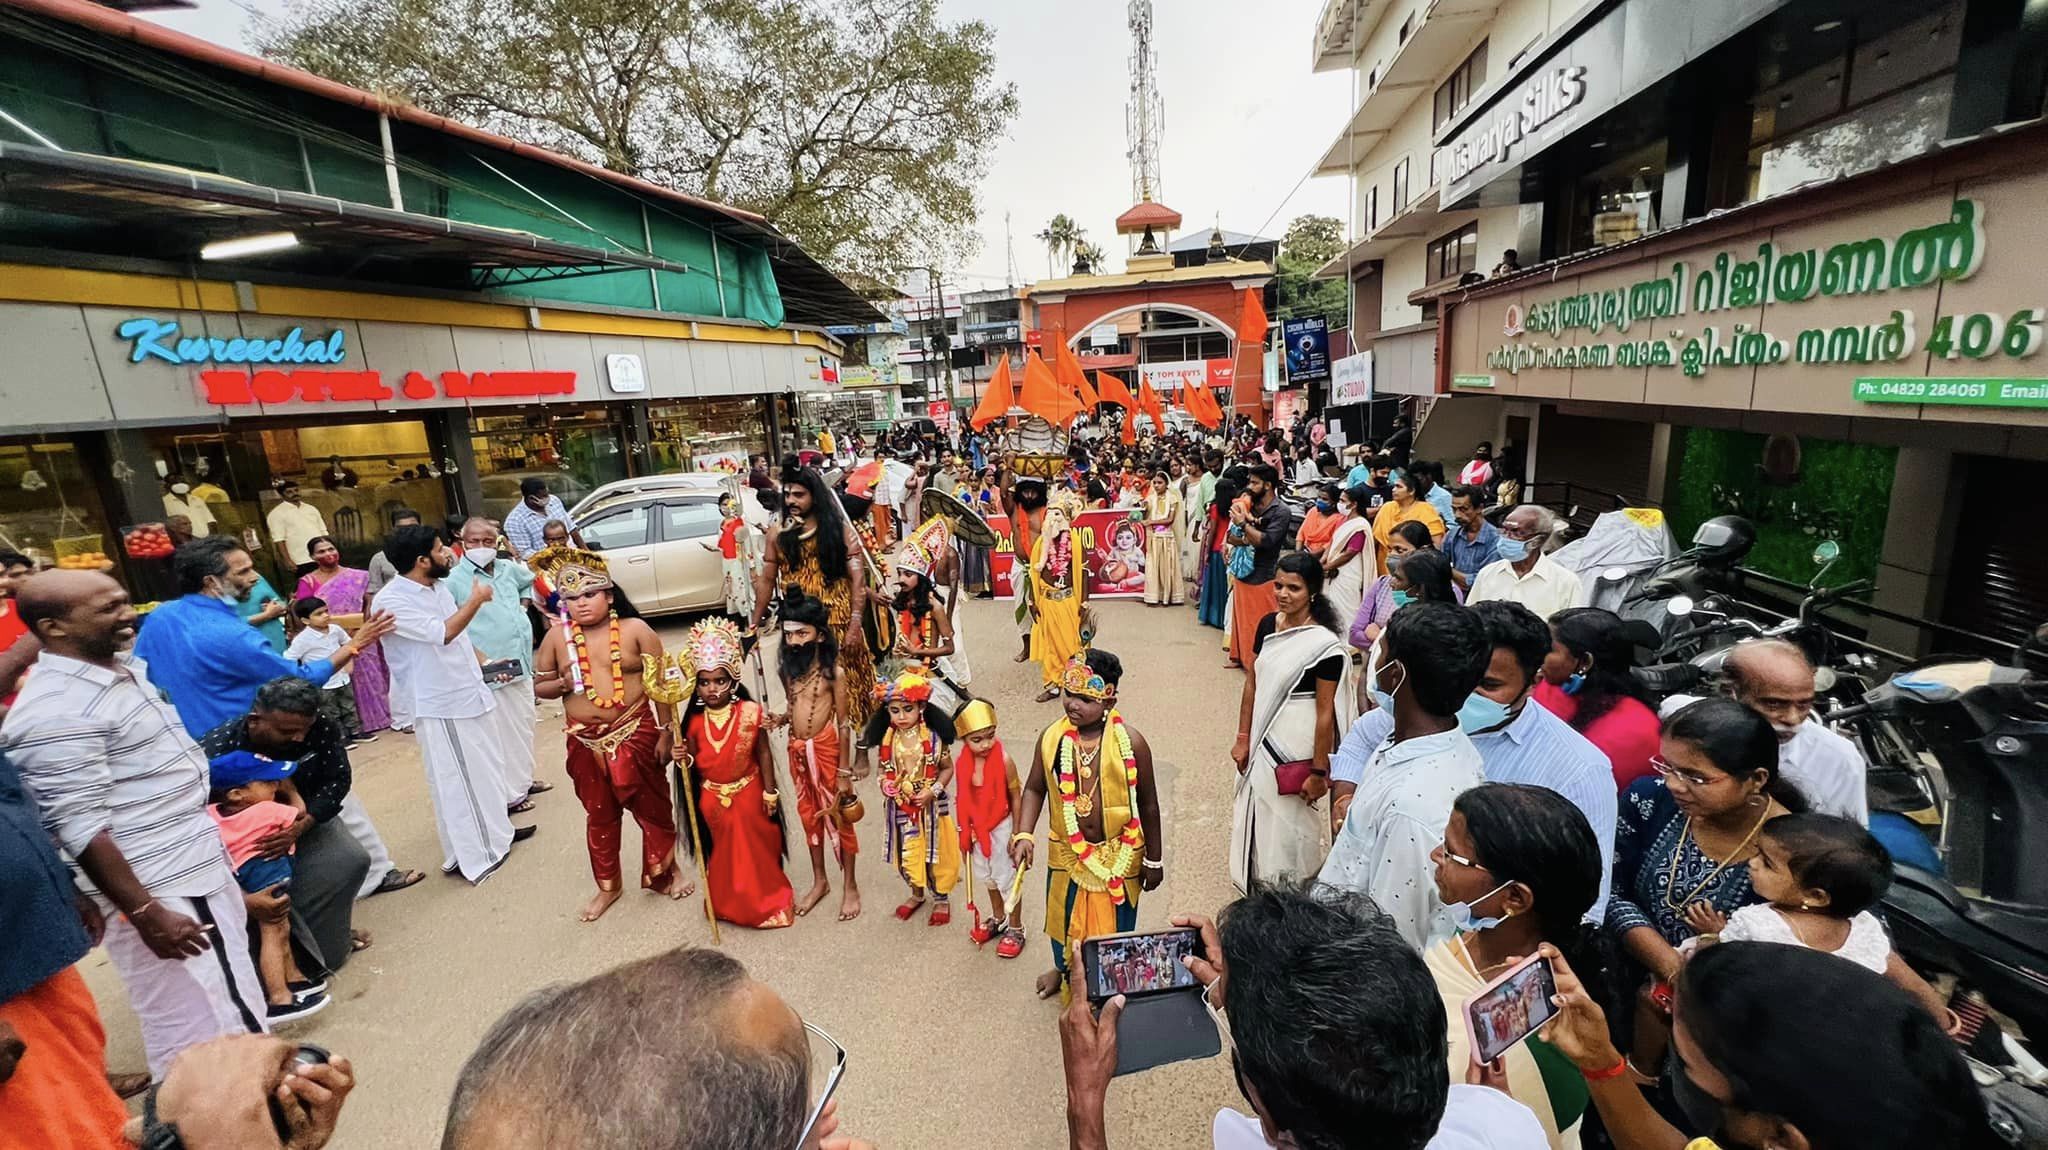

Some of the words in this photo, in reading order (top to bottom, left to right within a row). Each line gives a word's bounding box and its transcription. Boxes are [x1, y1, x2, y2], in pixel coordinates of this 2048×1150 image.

[1449, 111, 1521, 185] Aiswarya
[1521, 66, 1586, 134] Silks
[1525, 262, 1687, 338] കടുത്തുരുത്തി
[1694, 199, 1980, 312] റീജിയണൽ
[118, 318, 346, 364] Kureechal
[1535, 346, 1612, 368] സഹകരണ
[1617, 330, 1682, 368] ബാങ്ക്
[1796, 310, 1908, 363] നമ്പർ
[1925, 309, 2041, 359] 406
[1157, 371, 1174, 379] TOM
[1344, 381, 1365, 399] STUDIO
[1858, 383, 1877, 395] Ph:
[1881, 383, 1926, 397] 04829
[1928, 384, 1986, 398] 284061
